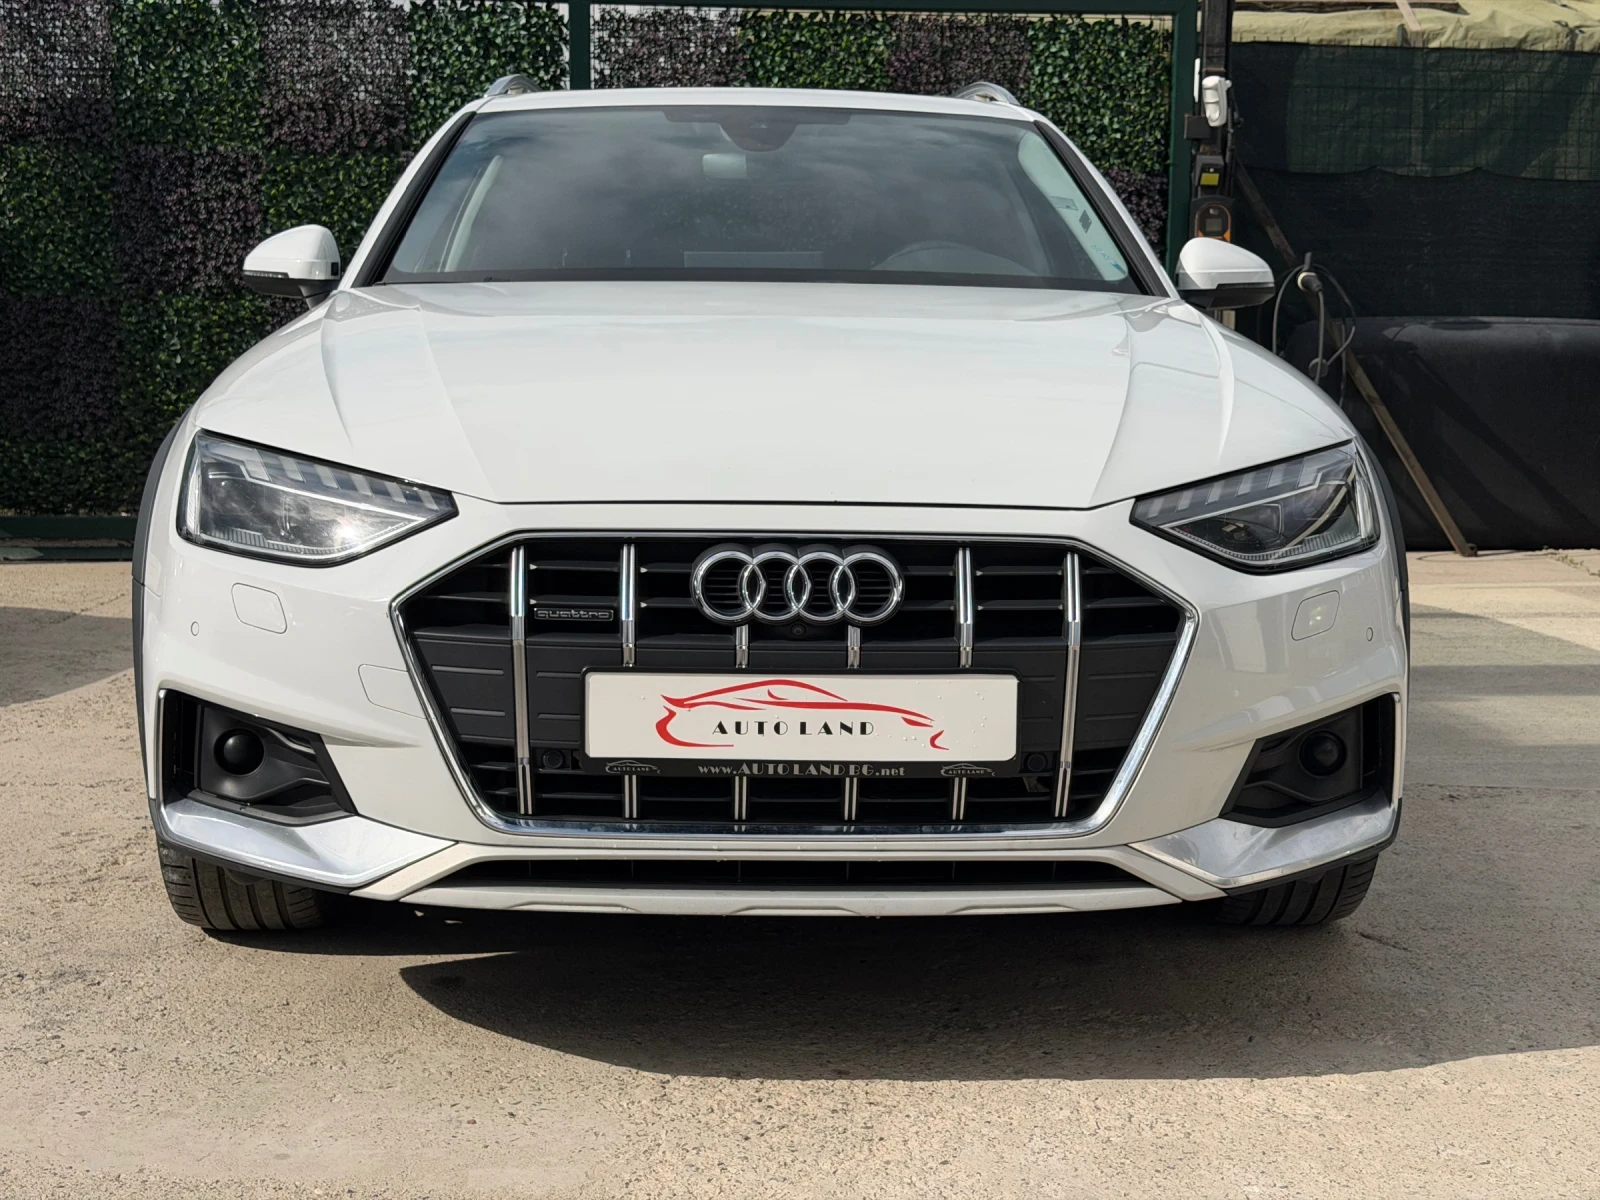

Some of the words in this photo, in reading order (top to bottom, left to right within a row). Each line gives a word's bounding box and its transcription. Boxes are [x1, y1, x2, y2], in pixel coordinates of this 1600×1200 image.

[538, 610, 609, 618] quattro
[712, 720, 788, 735] AUTO
[800, 721, 874, 735] LAND
